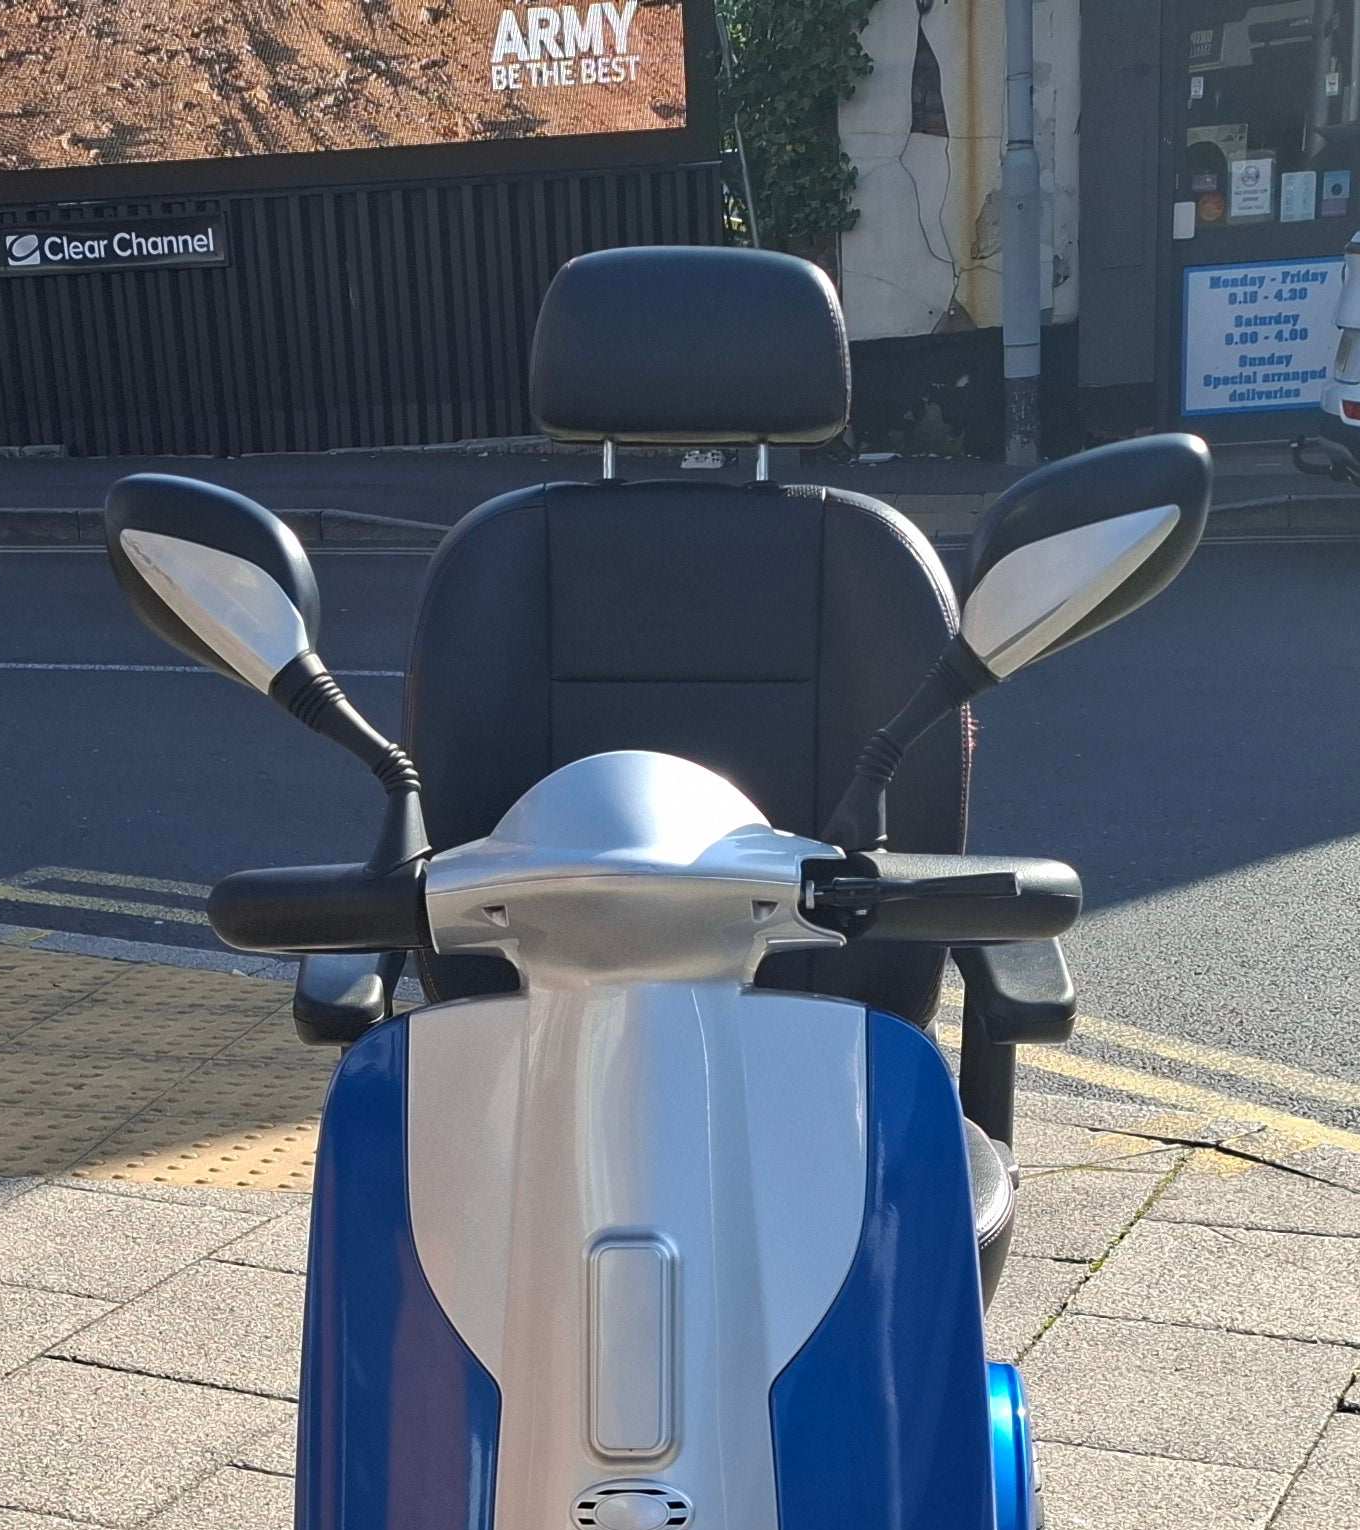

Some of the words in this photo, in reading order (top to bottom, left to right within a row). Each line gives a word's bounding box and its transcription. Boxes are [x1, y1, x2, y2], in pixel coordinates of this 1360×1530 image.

[490, 0, 639, 63] ARMY
[492, 63, 522, 90] BE
[527, 60, 575, 87] THE
[581, 55, 640, 85] BEST
[44, 236, 108, 261] Clear
[112, 228, 214, 258] Channel
[1208, 274, 1265, 290] Monday
[1281, 269, 1328, 285] Friday
[1234, 312, 1300, 328] Saturday
[1238, 353, 1293, 368] Sunday
[1203, 371, 1257, 389] Special
[1262, 366, 1327, 384] arranged
[1229, 386, 1301, 402] deliveries
